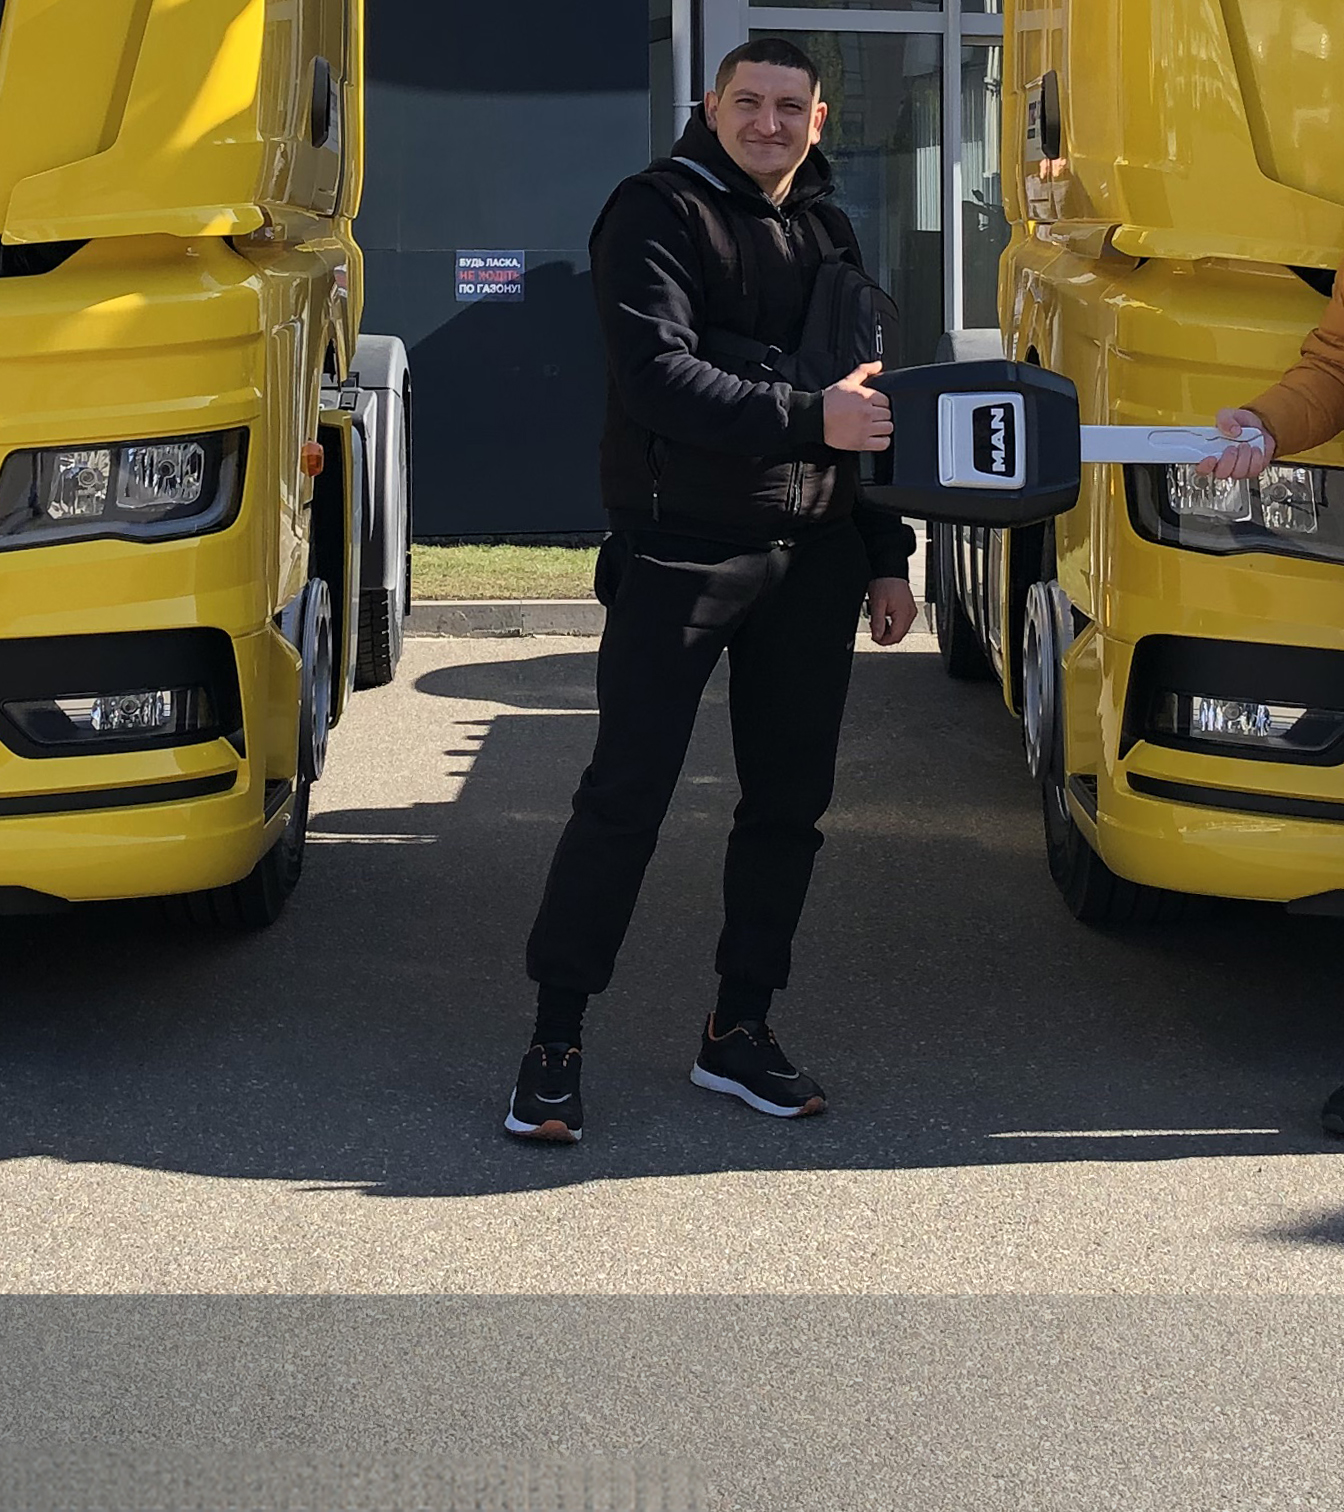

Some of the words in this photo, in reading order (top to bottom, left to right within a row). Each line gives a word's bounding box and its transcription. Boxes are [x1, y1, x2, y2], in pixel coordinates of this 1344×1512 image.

[459, 258, 484, 267] БУДЬ
[486, 258, 521, 268] ЛАСКА,
[459, 284, 475, 294] ПО
[477, 284, 521, 294] ГАЗОНУ!
[991, 408, 1005, 472] MAN
